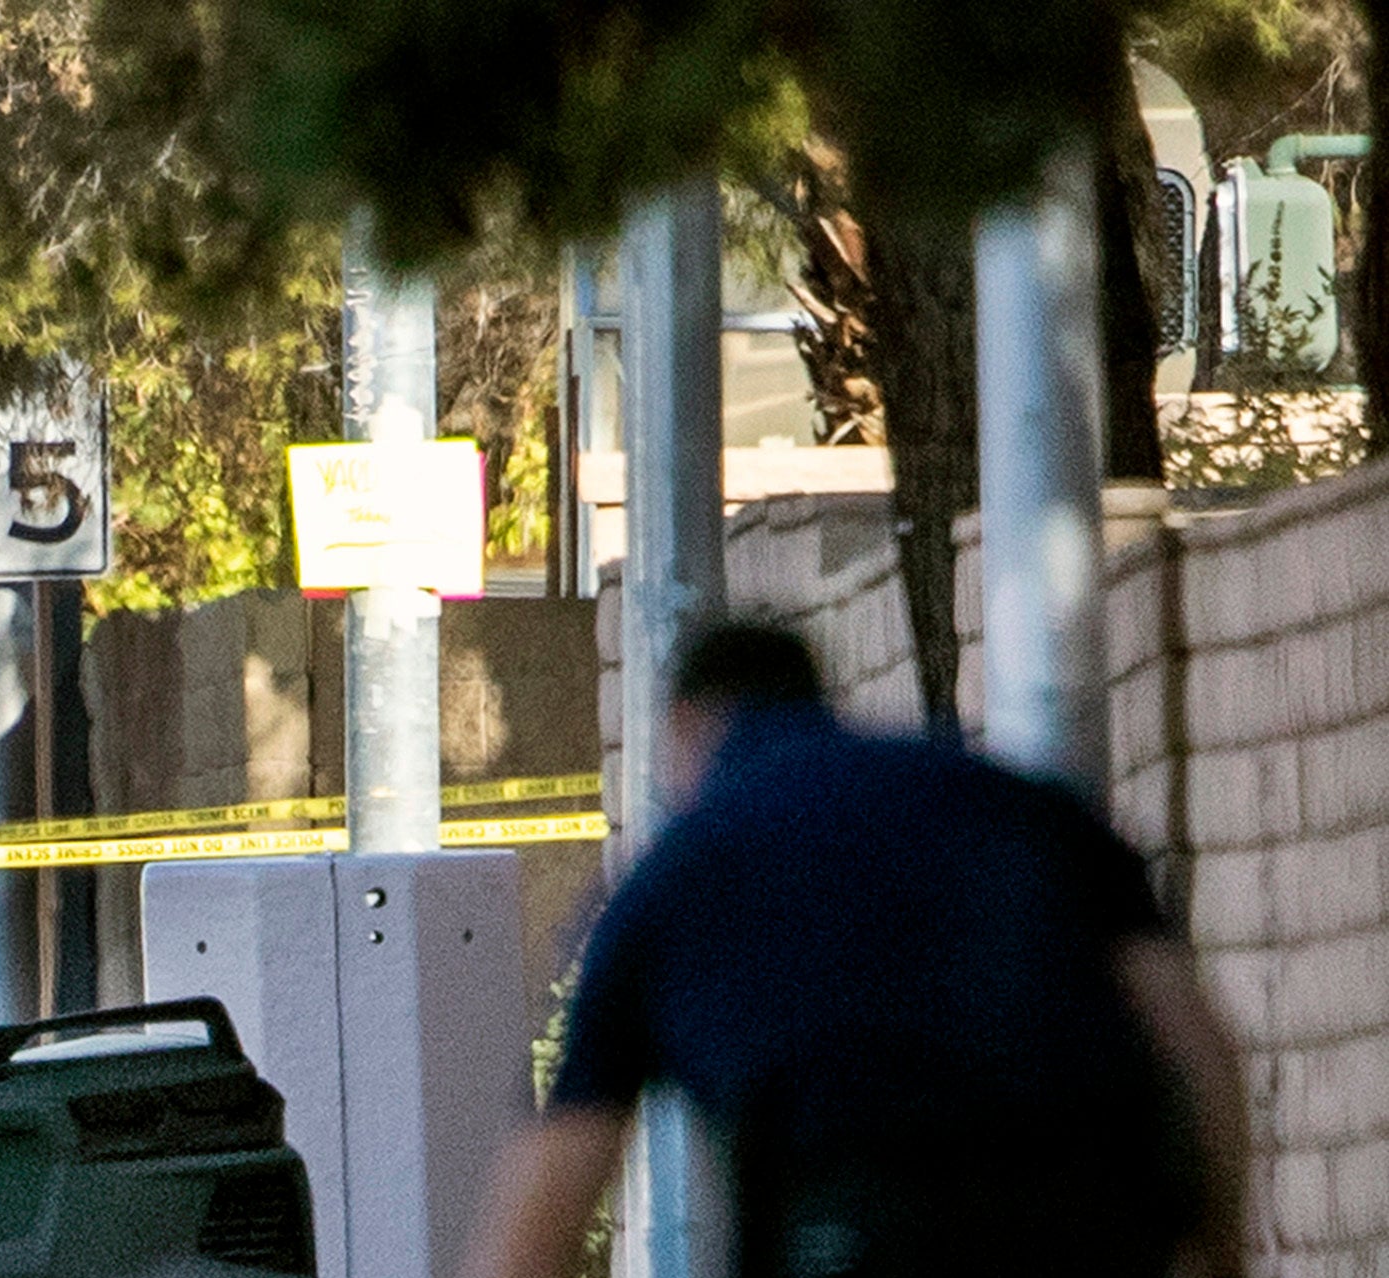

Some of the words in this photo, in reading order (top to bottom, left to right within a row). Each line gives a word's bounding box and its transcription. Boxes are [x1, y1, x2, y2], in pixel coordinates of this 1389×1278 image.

[233, 806, 269, 821] SCENE
[501, 823, 549, 837] CROSS
[555, 821, 582, 835] NOT
[171, 840, 199, 854] NOT
[203, 838, 223, 852] DO
[239, 836, 269, 850] LINE
[275, 833, 324, 848] POLICE
[6, 848, 51, 862] SCENE
[56, 845, 103, 860] CRIME
[117, 843, 165, 857] CROSS
